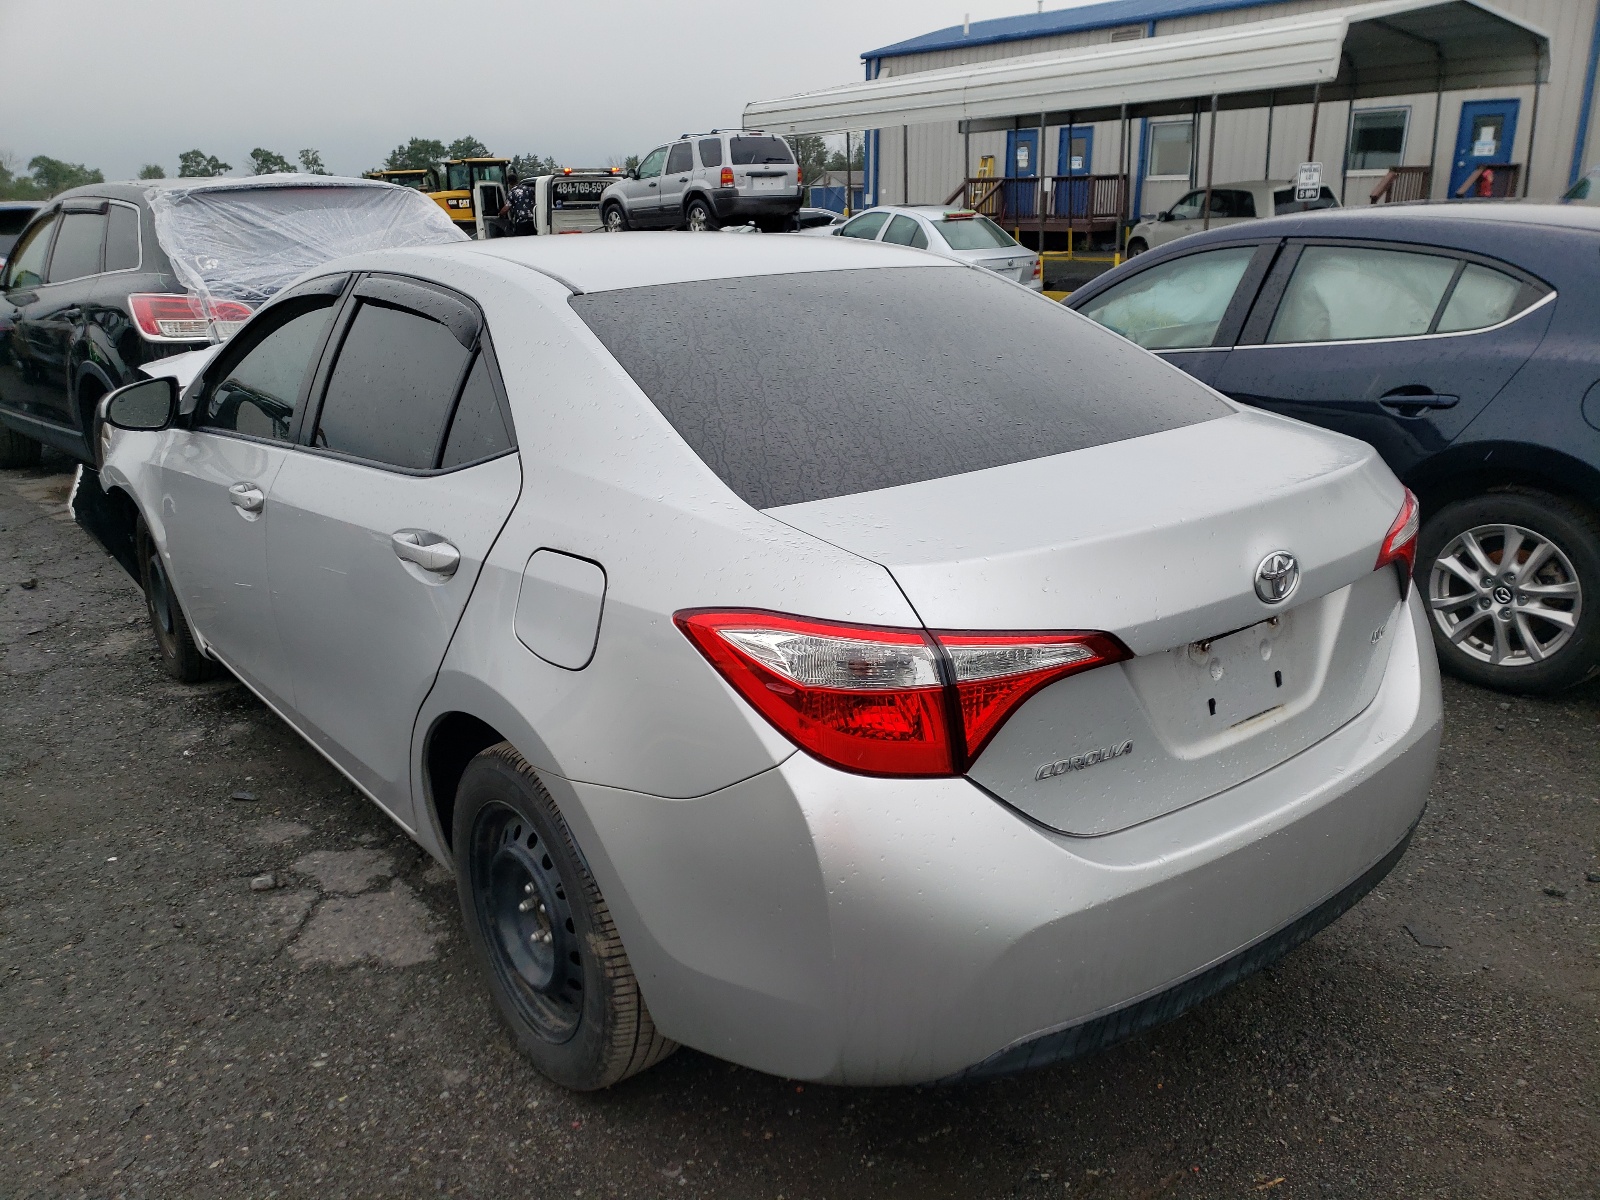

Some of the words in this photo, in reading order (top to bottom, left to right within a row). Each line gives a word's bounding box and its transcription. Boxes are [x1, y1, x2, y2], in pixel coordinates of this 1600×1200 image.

[1299, 190, 1305, 198] 5
[1305, 189, 1317, 198] MPH
[459, 199, 470, 208] CAT
[1035, 739, 1134, 781] COROLLA
